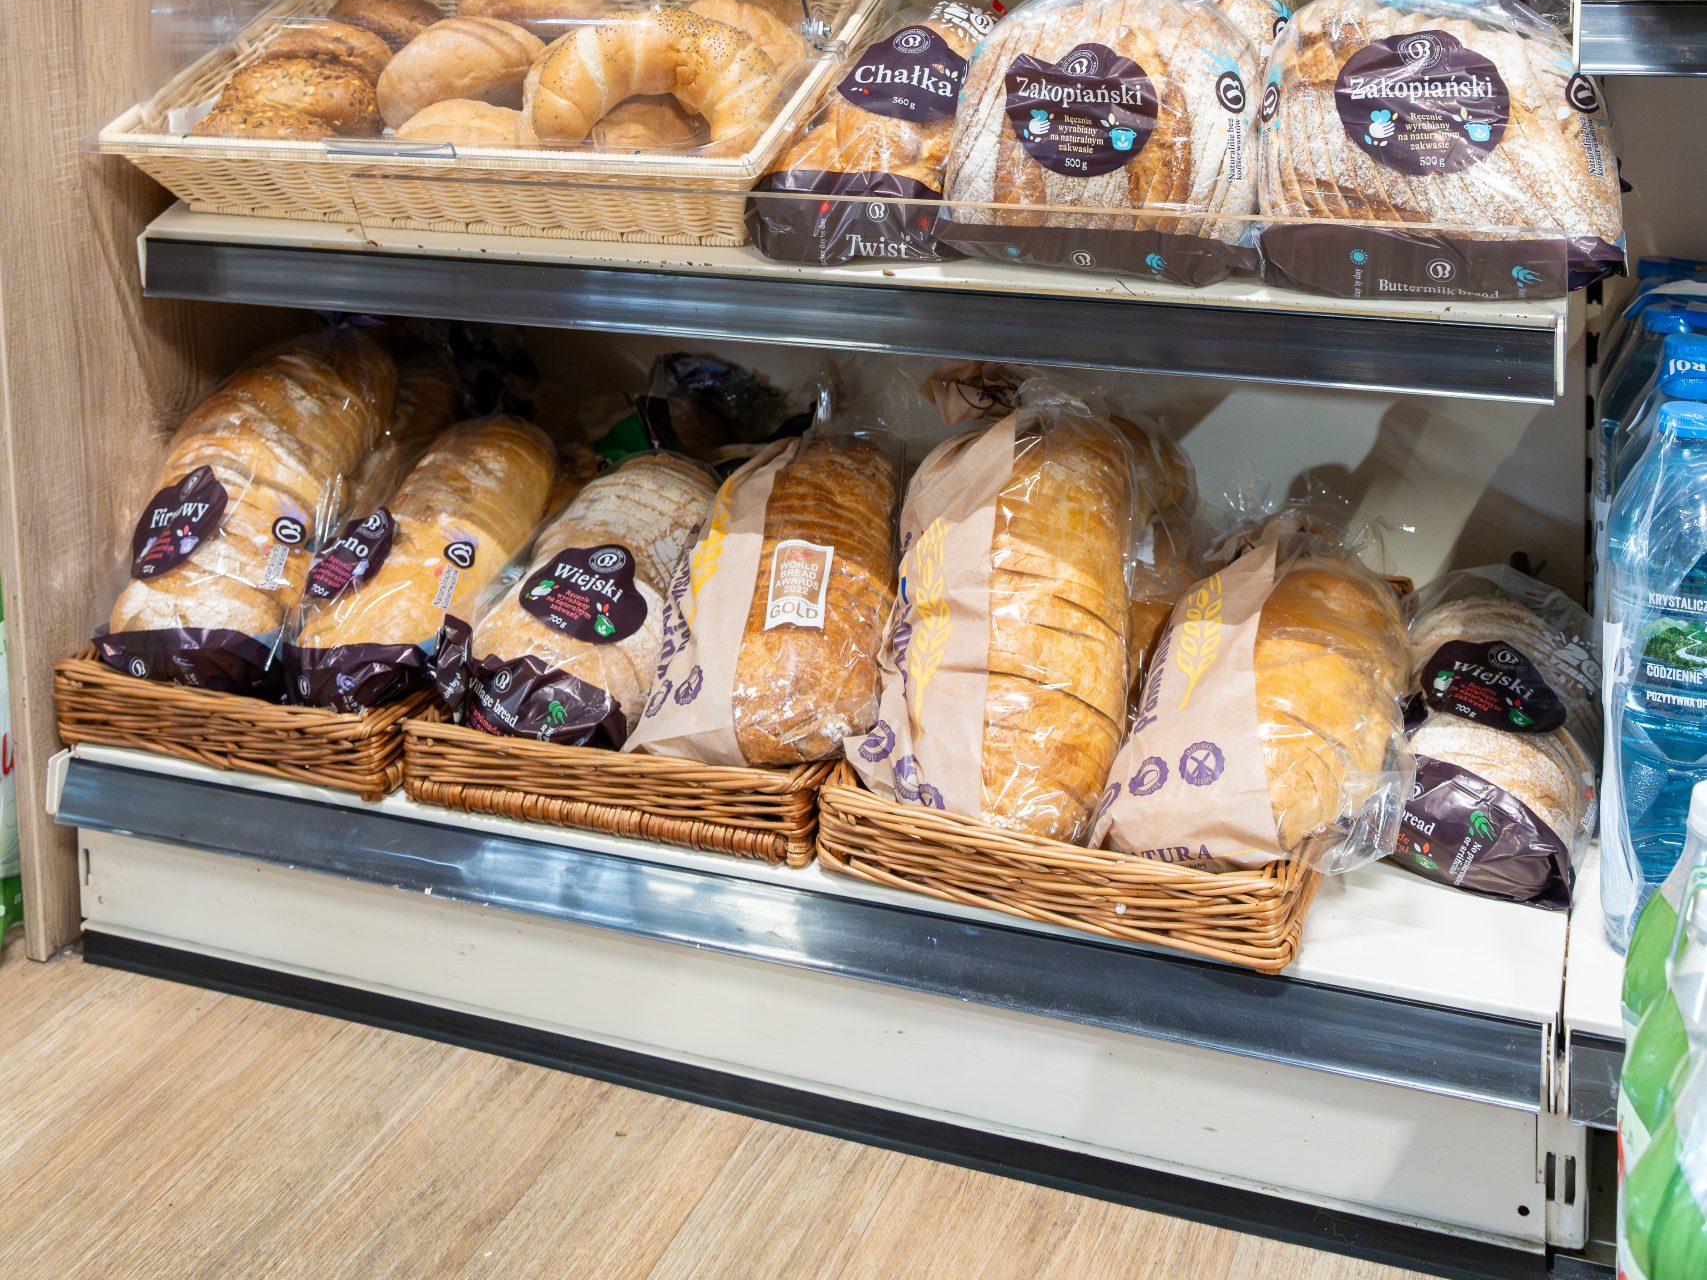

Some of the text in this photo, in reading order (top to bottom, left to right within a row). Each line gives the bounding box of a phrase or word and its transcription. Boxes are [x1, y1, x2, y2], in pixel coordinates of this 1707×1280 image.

[854, 63, 954, 98] Chałka
[1016, 76, 1143, 108] Zakopiański
[1349, 74, 1493, 104] Zakopiański
[891, 96, 916, 110] 360 g
[1063, 114, 1093, 125] Ręcznie
[1410, 112, 1443, 122] Ręcznie
[1058, 123, 1098, 136] wyrabiany
[1405, 122, 1450, 132] wyrabiany
[1060, 134, 1104, 146] naturalnym
[1410, 130, 1460, 141] naturalnym
[1058, 144, 1094, 154] zakwasie
[1227, 117, 1237, 181] Naturalnie bez
[1235, 118, 1243, 181] konserwantów
[1410, 140, 1450, 151] zakwasie
[1064, 158, 1088, 171] 500 g
[1419, 156, 1446, 168] 500 g
[845, 233, 910, 259] Twist
[1378, 278, 1499, 300] Buttermilk bread
[780, 560, 819, 571] WORLD
[779, 568, 817, 580] BREAD
[310, 583, 324, 595] 700
[553, 562, 624, 604] Wiejski
[774, 577, 820, 592] AWARDS
[783, 585, 809, 596] 2022
[769, 600, 819, 620] GOLD
[549, 614, 563, 625] 700
[1452, 660, 1535, 700] Wiejski
[1646, 664, 1703, 685] CODZIENNE
[467, 676, 519, 729] Village bread
[1646, 690, 1695, 707] POZYTYWNA
[1455, 703, 1471, 714] 700
